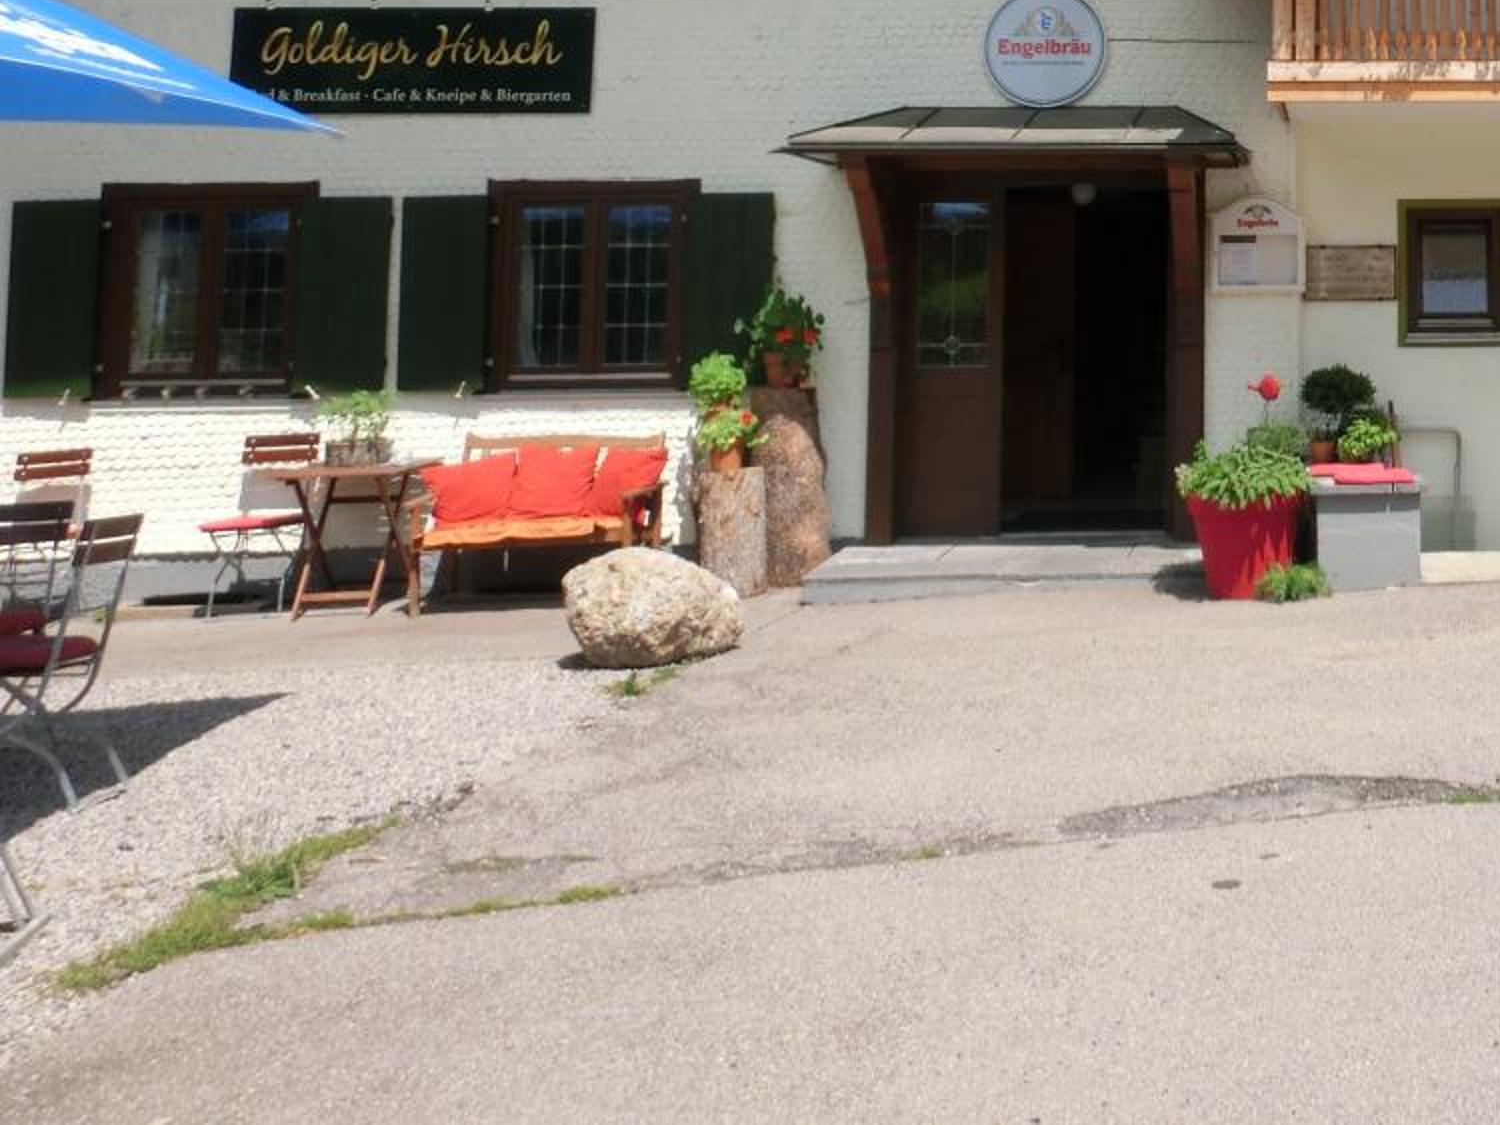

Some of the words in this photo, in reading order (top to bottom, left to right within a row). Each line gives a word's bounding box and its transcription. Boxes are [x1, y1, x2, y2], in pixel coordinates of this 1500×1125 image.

[261, 20, 417, 79] Goldiger
[426, 19, 563, 67] Hirsch
[998, 38, 1092, 59] Engelbräu
[294, 88, 361, 101] Breakfast
[410, 88, 421, 102] &
[426, 88, 477, 105] Kneipe
[480, 88, 493, 102] &
[497, 88, 571, 105] Biergarten
